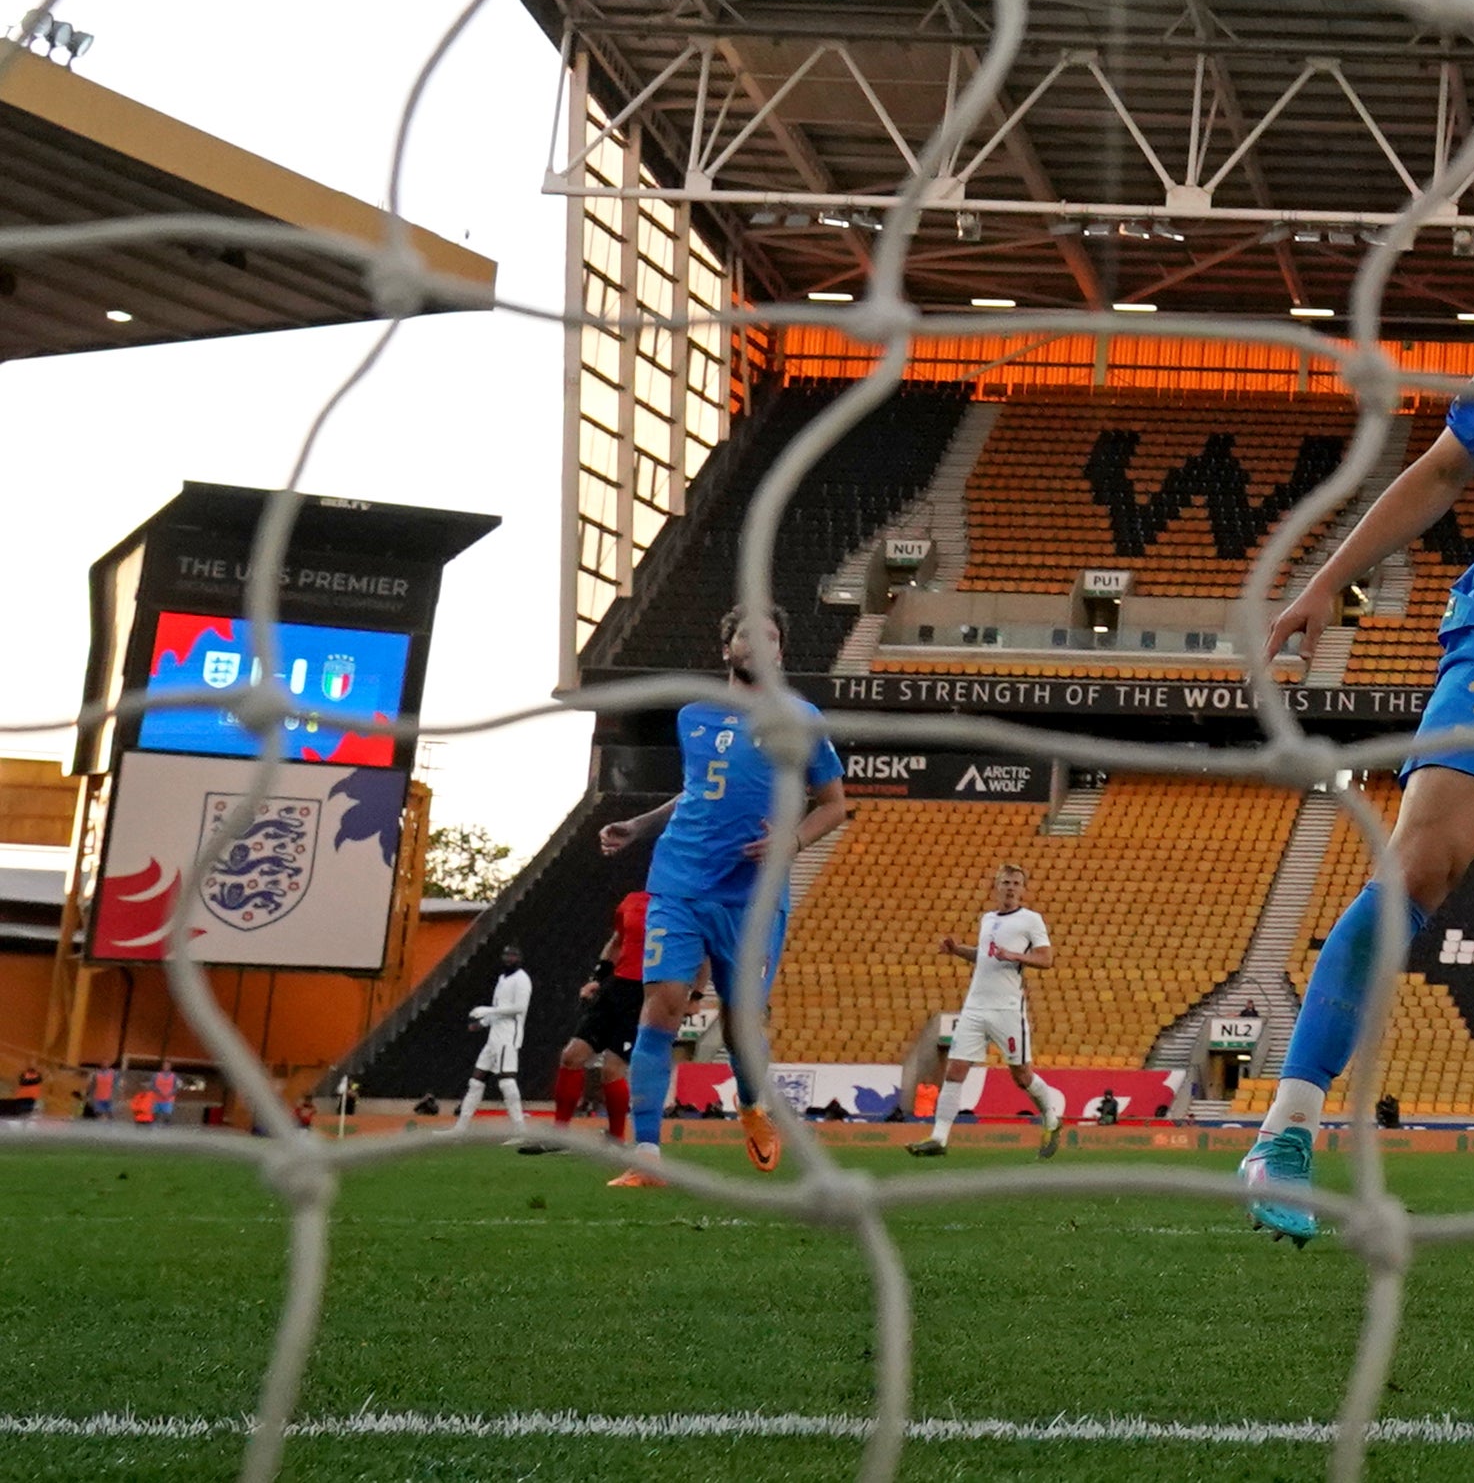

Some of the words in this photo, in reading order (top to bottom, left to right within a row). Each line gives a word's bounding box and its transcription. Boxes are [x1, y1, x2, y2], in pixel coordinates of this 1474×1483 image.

[893, 544, 923, 556] NU1
[178, 555, 227, 579] THE
[299, 567, 410, 598] PREMIER
[1093, 575, 1121, 588] PU1
[832, 678, 885, 700] THE
[900, 680, 1051, 705] STRENGTH
[1065, 685, 1100, 706] OF
[1115, 686, 1168, 708] THE
[1183, 688, 1261, 710] WOL
[1284, 690, 1309, 712] IS
[1325, 691, 1355, 713] IN
[1371, 692, 1423, 713] THE
[847, 754, 910, 779] RISK
[983, 765, 1032, 780] ARCTIC
[703, 761, 729, 801] 5
[988, 779, 1026, 793] WOLF
[644, 927, 667, 967] 5
[1220, 1023, 1253, 1037] NL2
